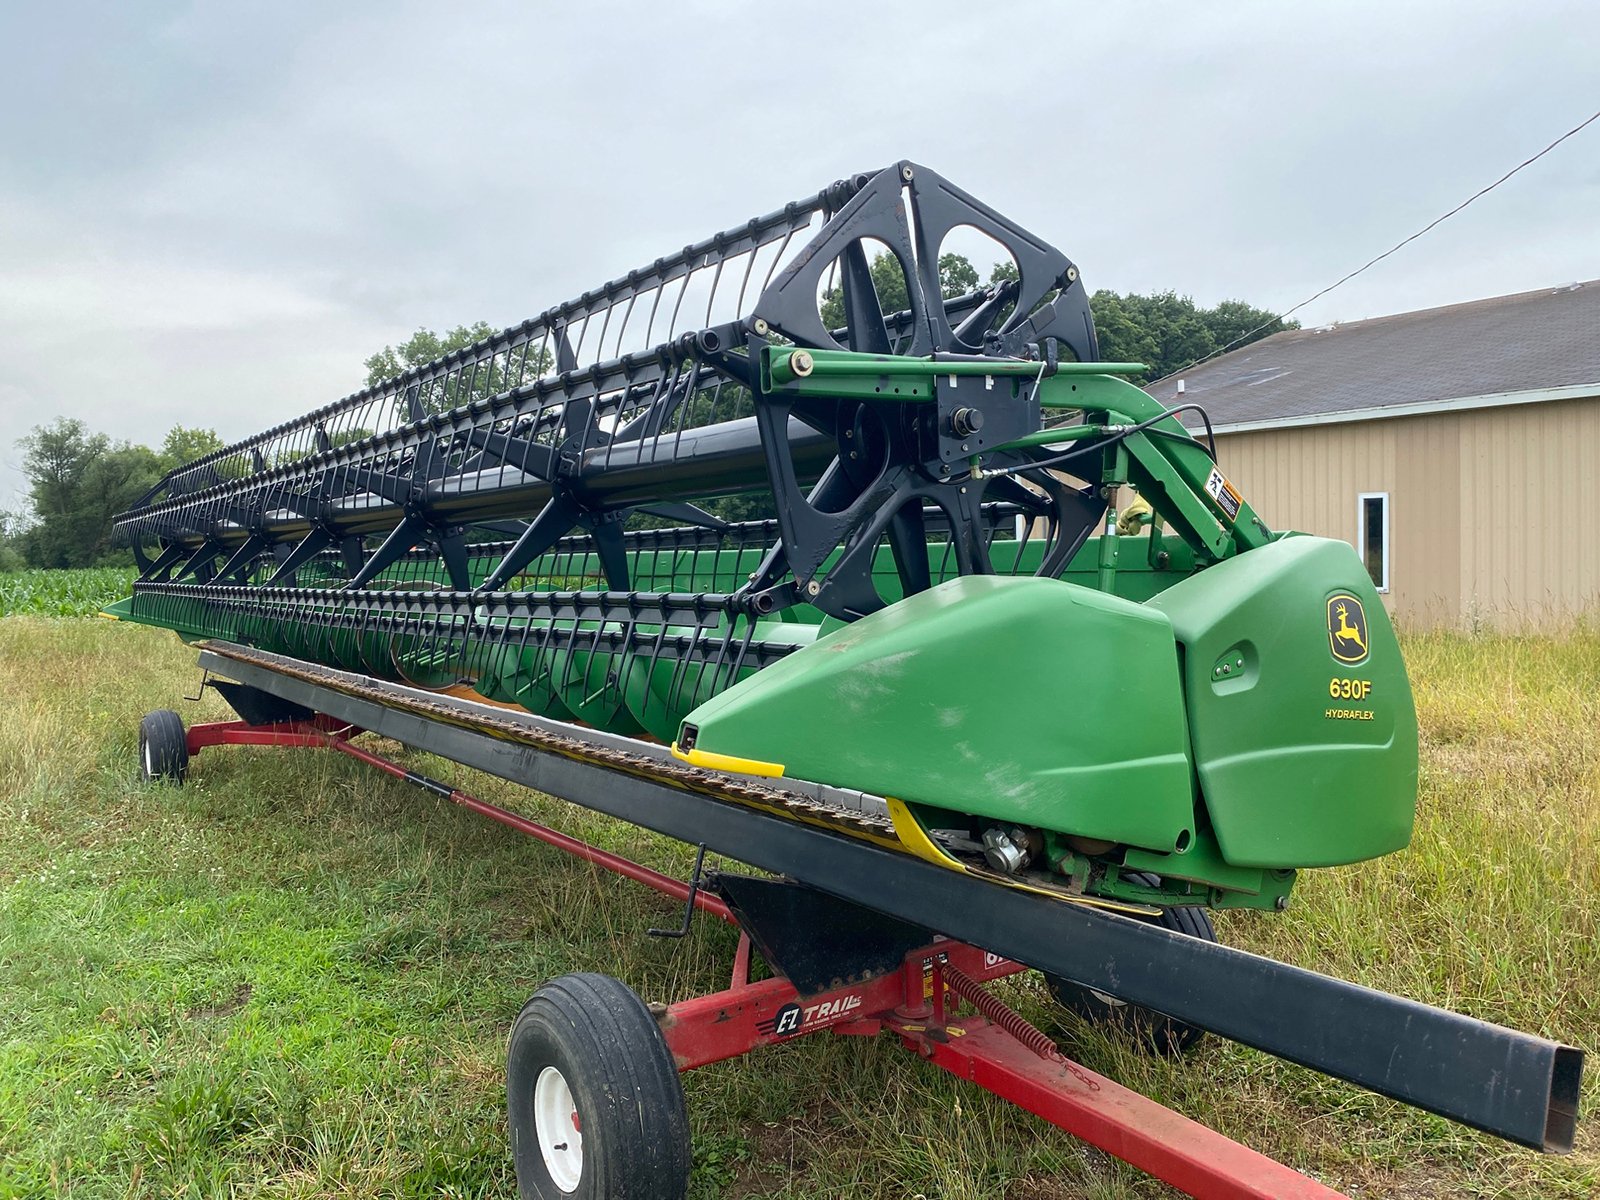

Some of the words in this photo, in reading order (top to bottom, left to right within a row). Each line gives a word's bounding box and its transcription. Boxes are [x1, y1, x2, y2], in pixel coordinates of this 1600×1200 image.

[1329, 677, 1371, 699] 630F
[1325, 708, 1374, 720] HYDRAFLEX
[803, 994, 861, 1022] TRAIL
